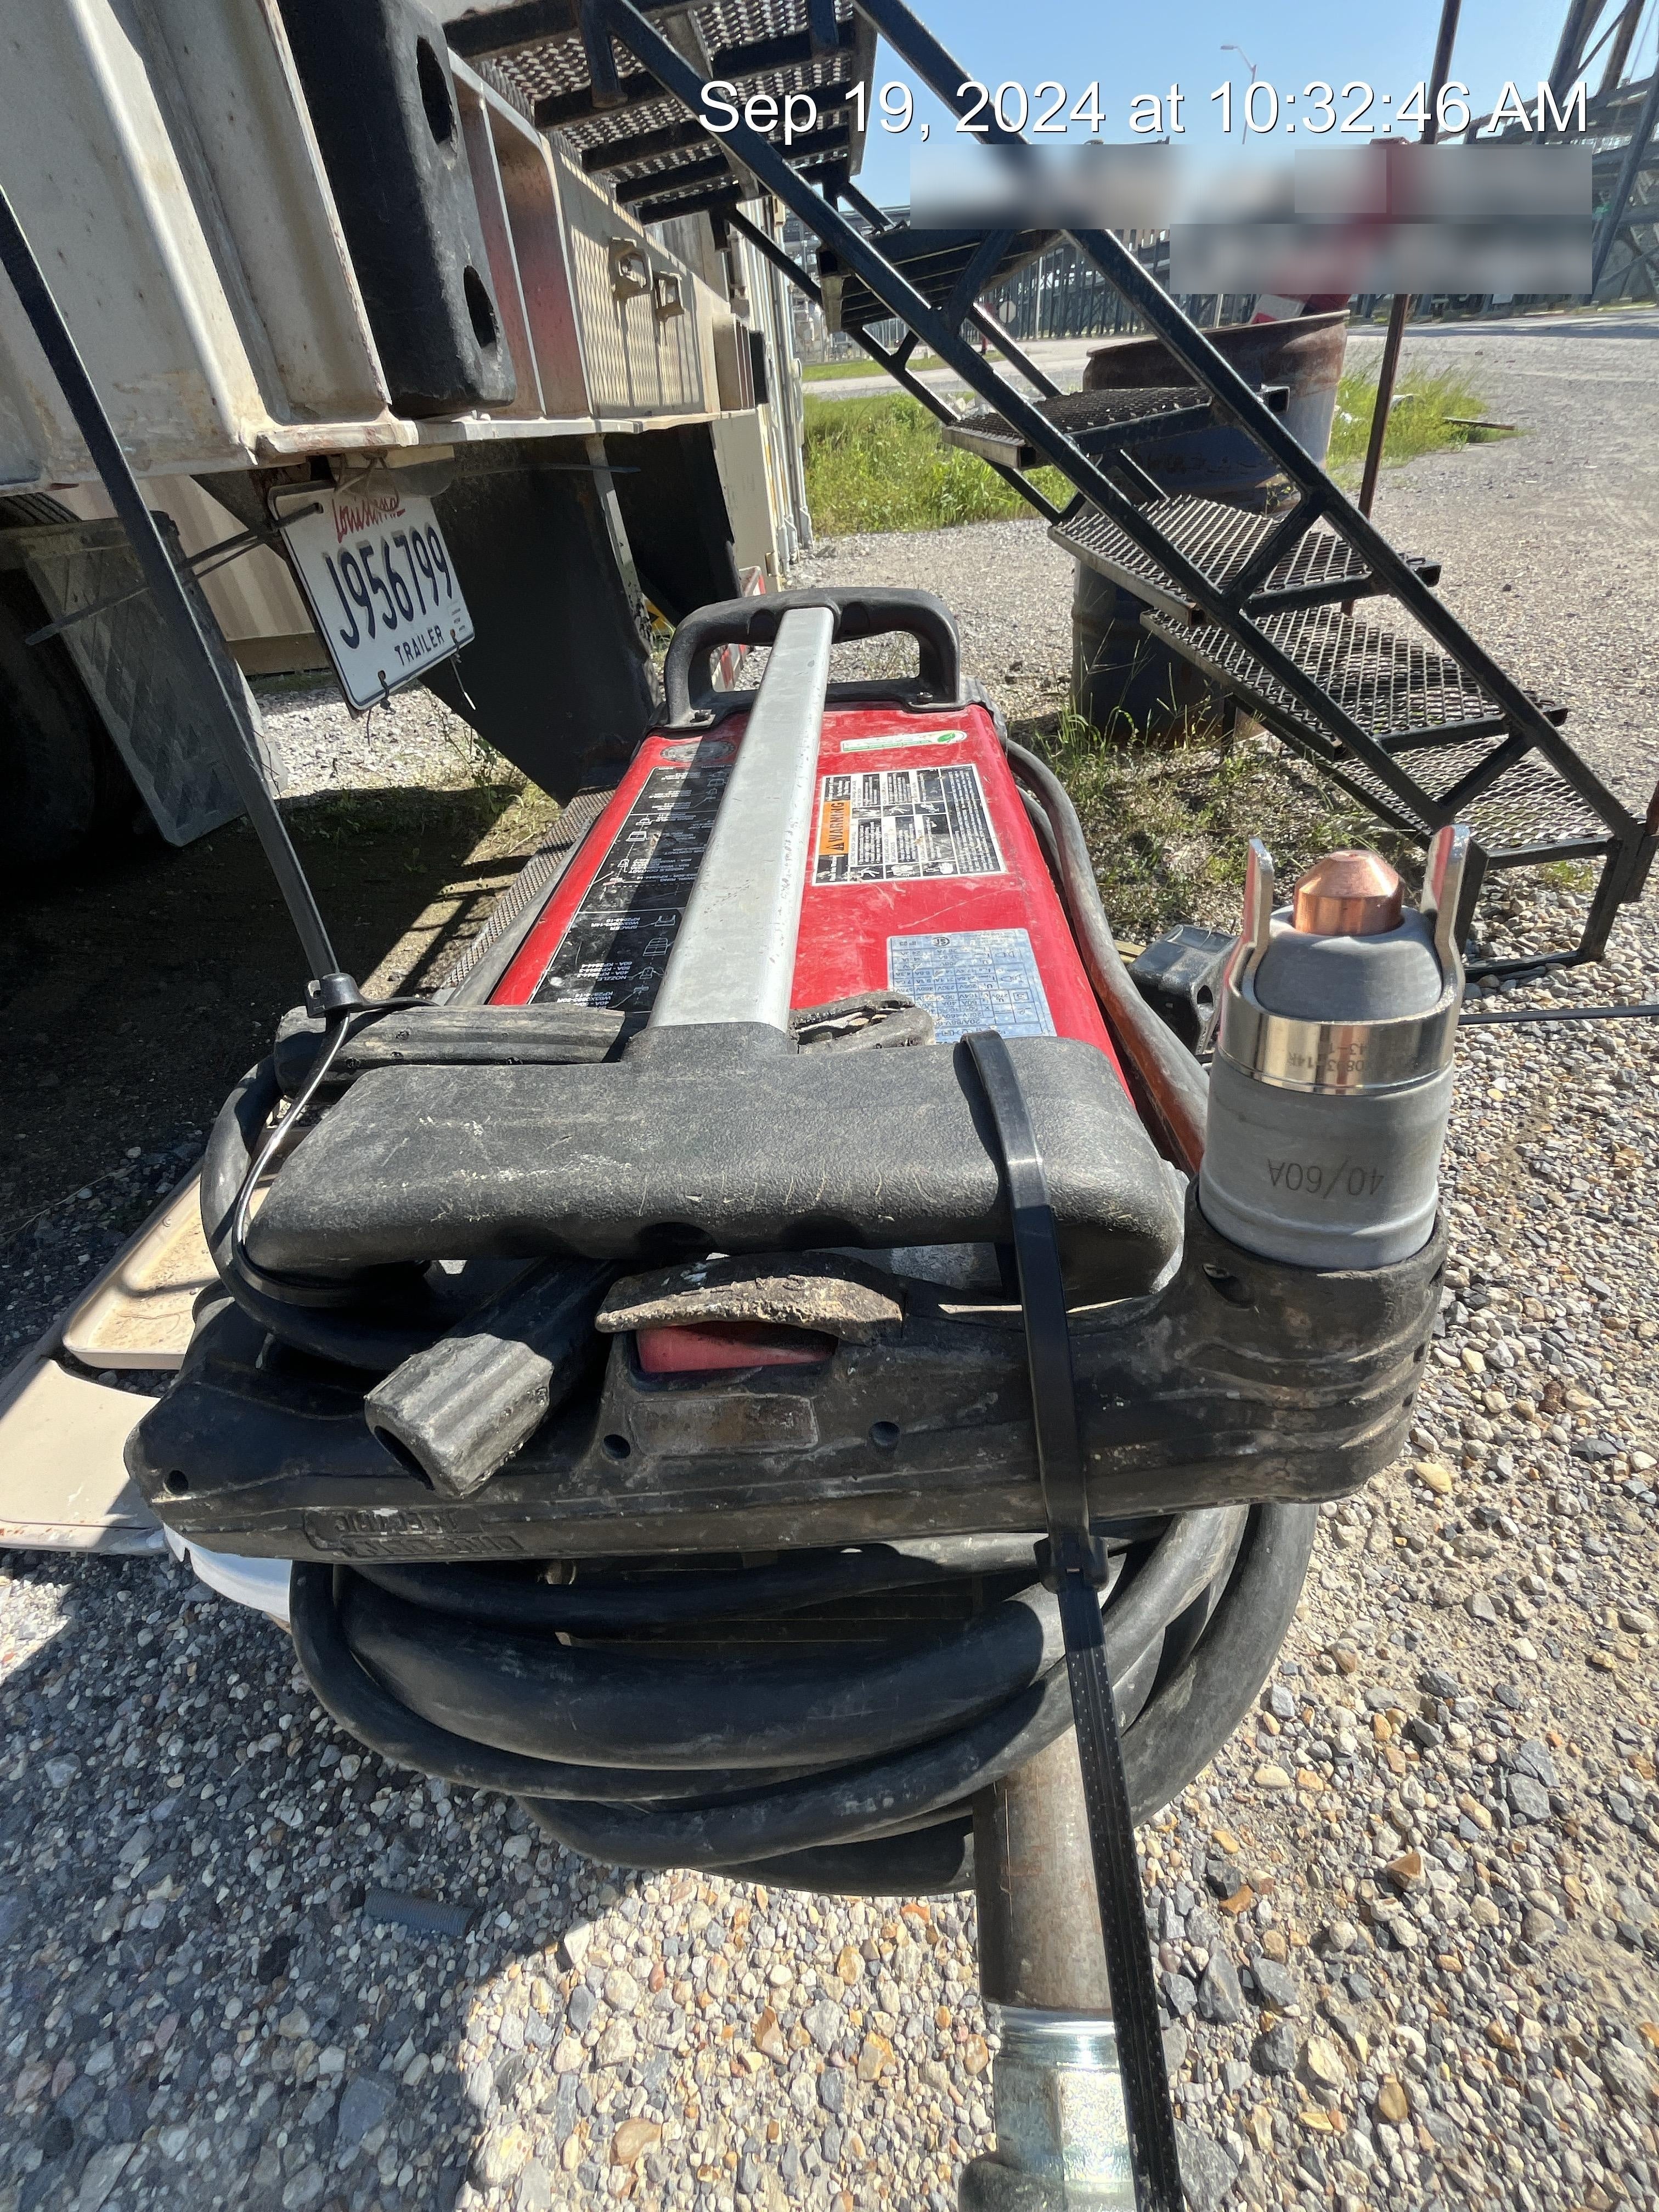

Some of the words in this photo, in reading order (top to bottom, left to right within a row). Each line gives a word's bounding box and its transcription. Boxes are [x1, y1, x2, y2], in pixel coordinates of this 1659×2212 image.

[324, 525, 452, 648] J956799
[394, 626, 444, 665] TRAILER
[828, 803, 844, 842] WARNING
[1267, 1159, 1384, 1199] 40/60A
